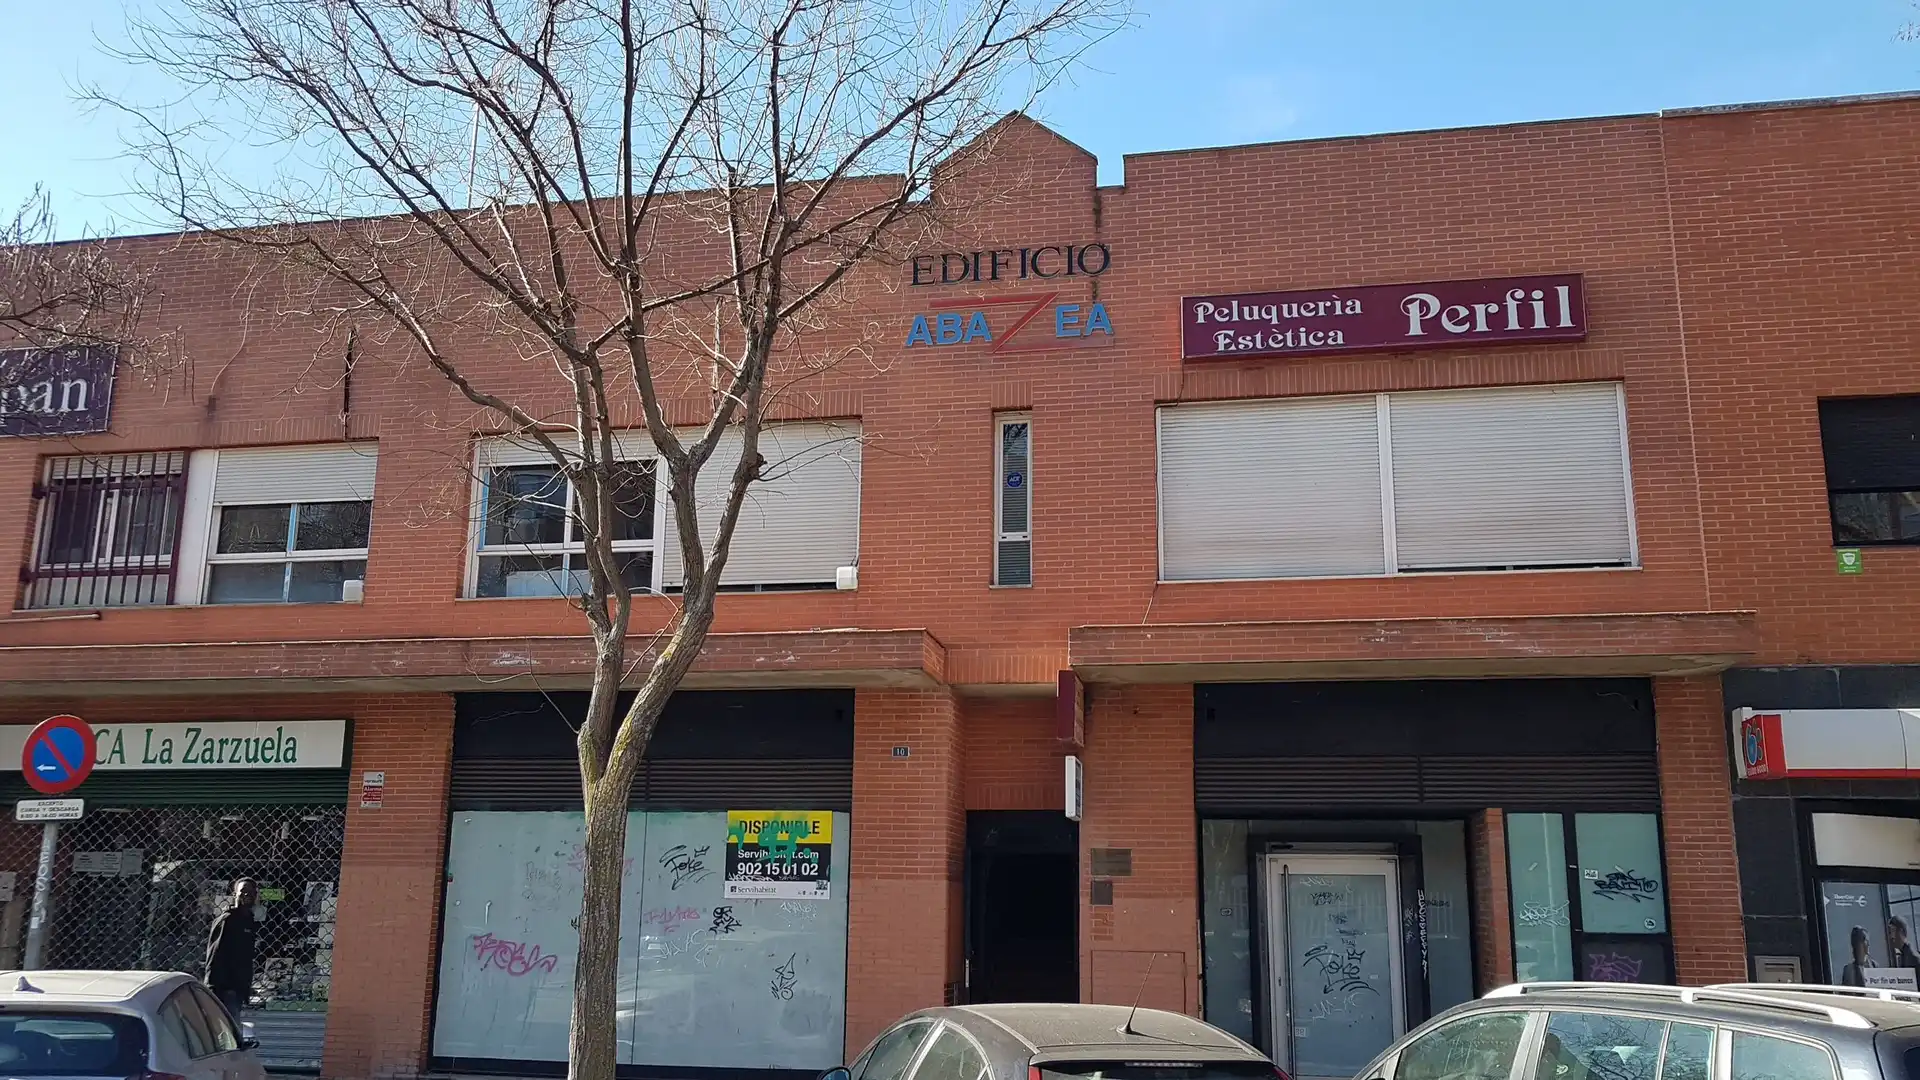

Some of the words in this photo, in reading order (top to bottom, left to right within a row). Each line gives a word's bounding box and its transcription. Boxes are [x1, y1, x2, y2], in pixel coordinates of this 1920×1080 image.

[911, 243, 1112, 286] EDIFICIO
[1400, 285, 1577, 337] Perfil
[142, 728, 173, 764] La
[181, 726, 297, 764] Zarzuela
[896, 747, 905, 756] 10
[738, 848, 819, 859] Servihbitt.com
[737, 863, 762, 876] 902
[765, 863, 780, 876] 15
[782, 863, 798, 876] 01
[801, 863, 819, 876] 02
[738, 885, 777, 894] Servihabitat
